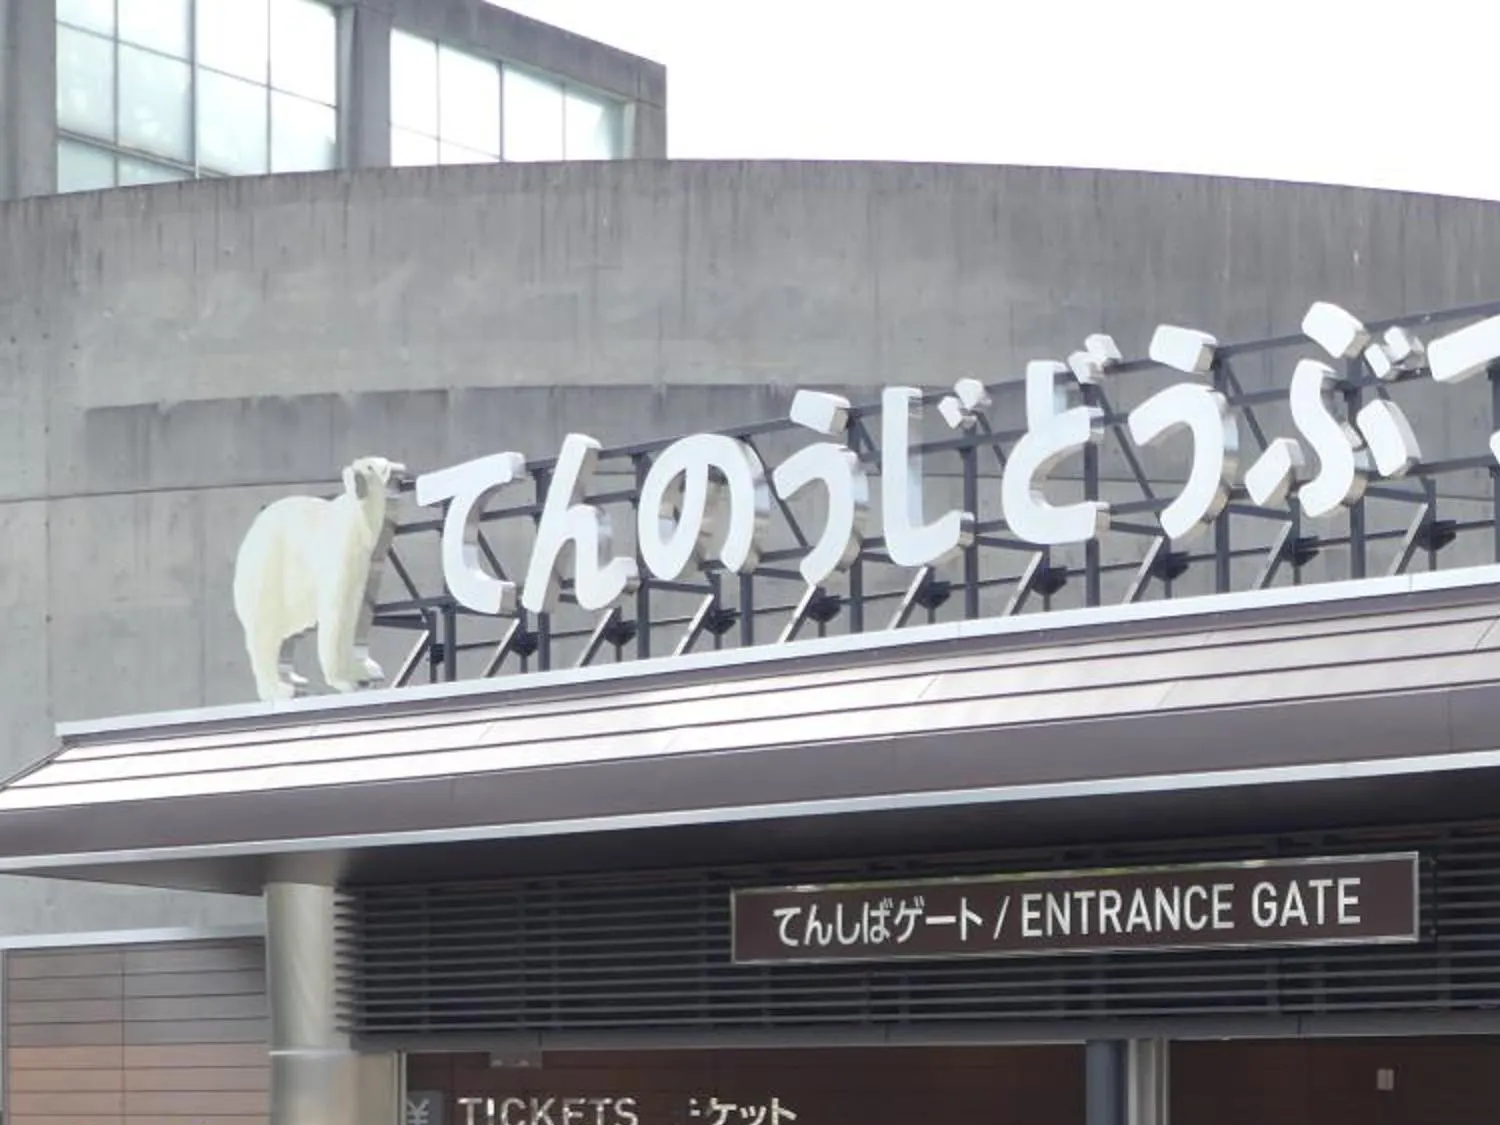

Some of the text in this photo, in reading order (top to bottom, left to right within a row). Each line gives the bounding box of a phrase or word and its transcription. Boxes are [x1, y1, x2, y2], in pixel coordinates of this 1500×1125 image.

[772, 896, 984, 947] てんしばゲート
[1020, 883, 1236, 938] ENTRANCE
[1251, 877, 1362, 927] GATE
